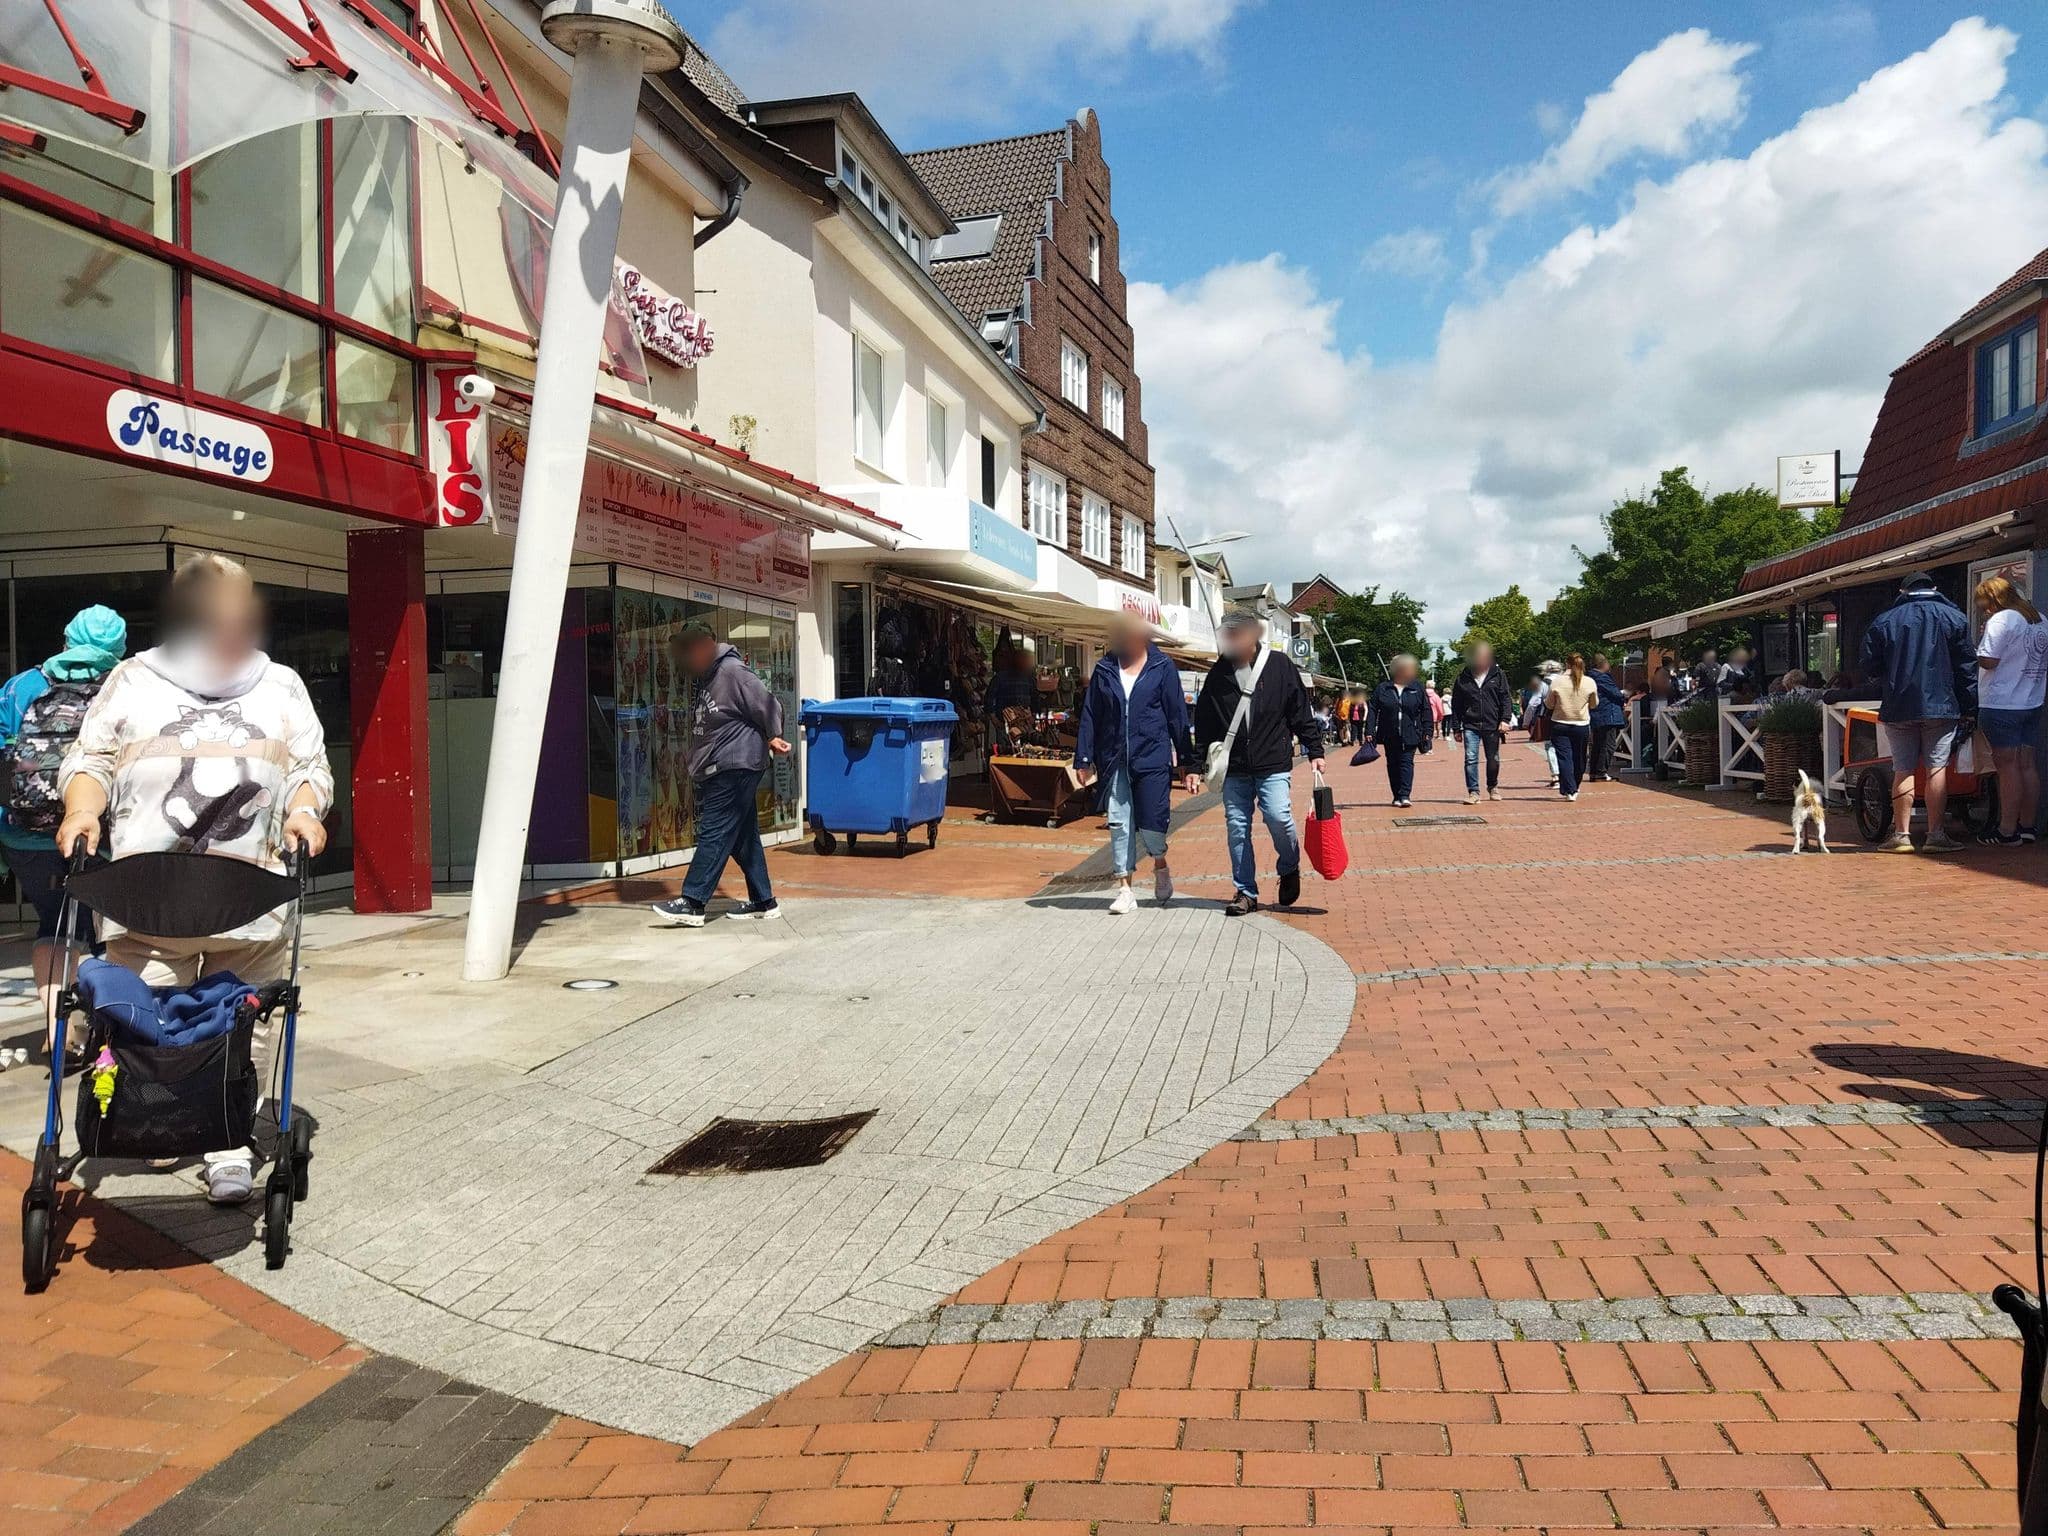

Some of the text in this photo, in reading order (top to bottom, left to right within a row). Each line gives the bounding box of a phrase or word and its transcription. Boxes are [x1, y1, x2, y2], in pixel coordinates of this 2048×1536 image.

[119, 401, 268, 476] Passage
[433, 366, 484, 527] EIS
[498, 481, 519, 493] NUTELLA
